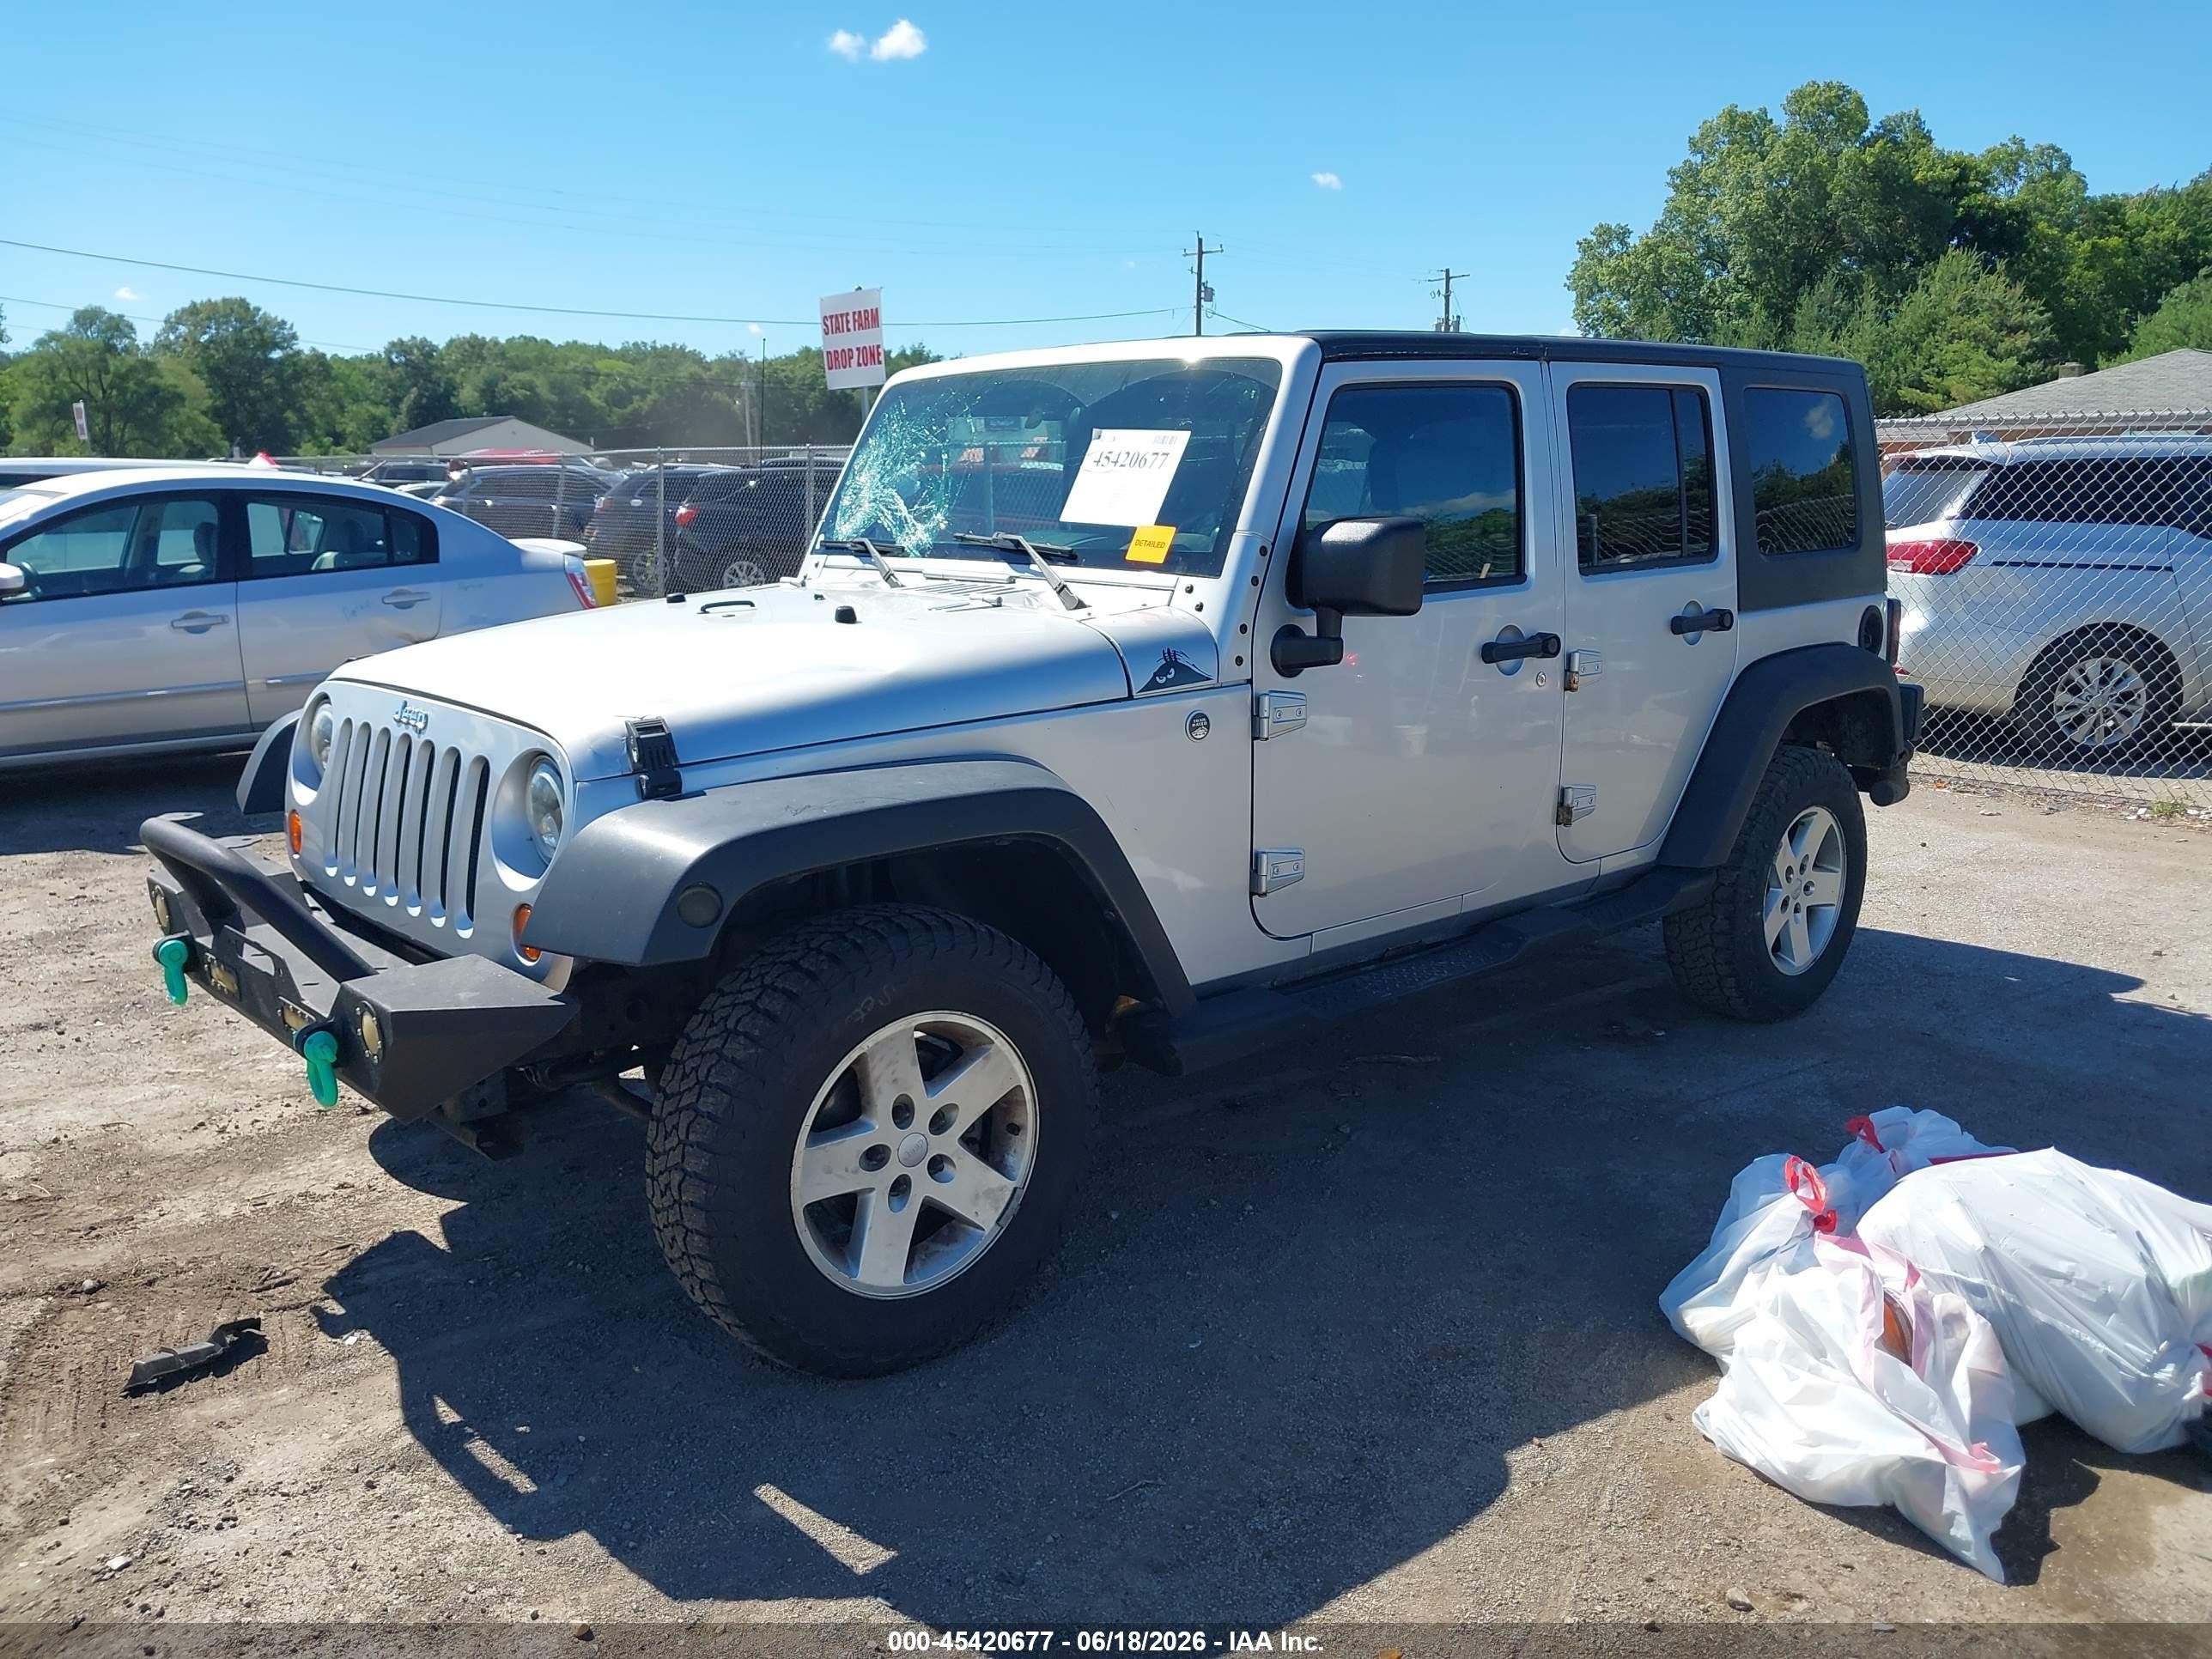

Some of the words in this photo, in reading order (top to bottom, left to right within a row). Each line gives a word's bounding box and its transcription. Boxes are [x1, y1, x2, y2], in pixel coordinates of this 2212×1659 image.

[823, 312, 851, 336] STATE
[852, 307, 879, 331] FARM
[825, 349, 854, 371] DROP
[856, 344, 882, 368] ZONE
[1093, 451, 1170, 470] 45420677
[1134, 538, 1166, 549] DETAILED
[392, 700, 428, 733] Jeep
